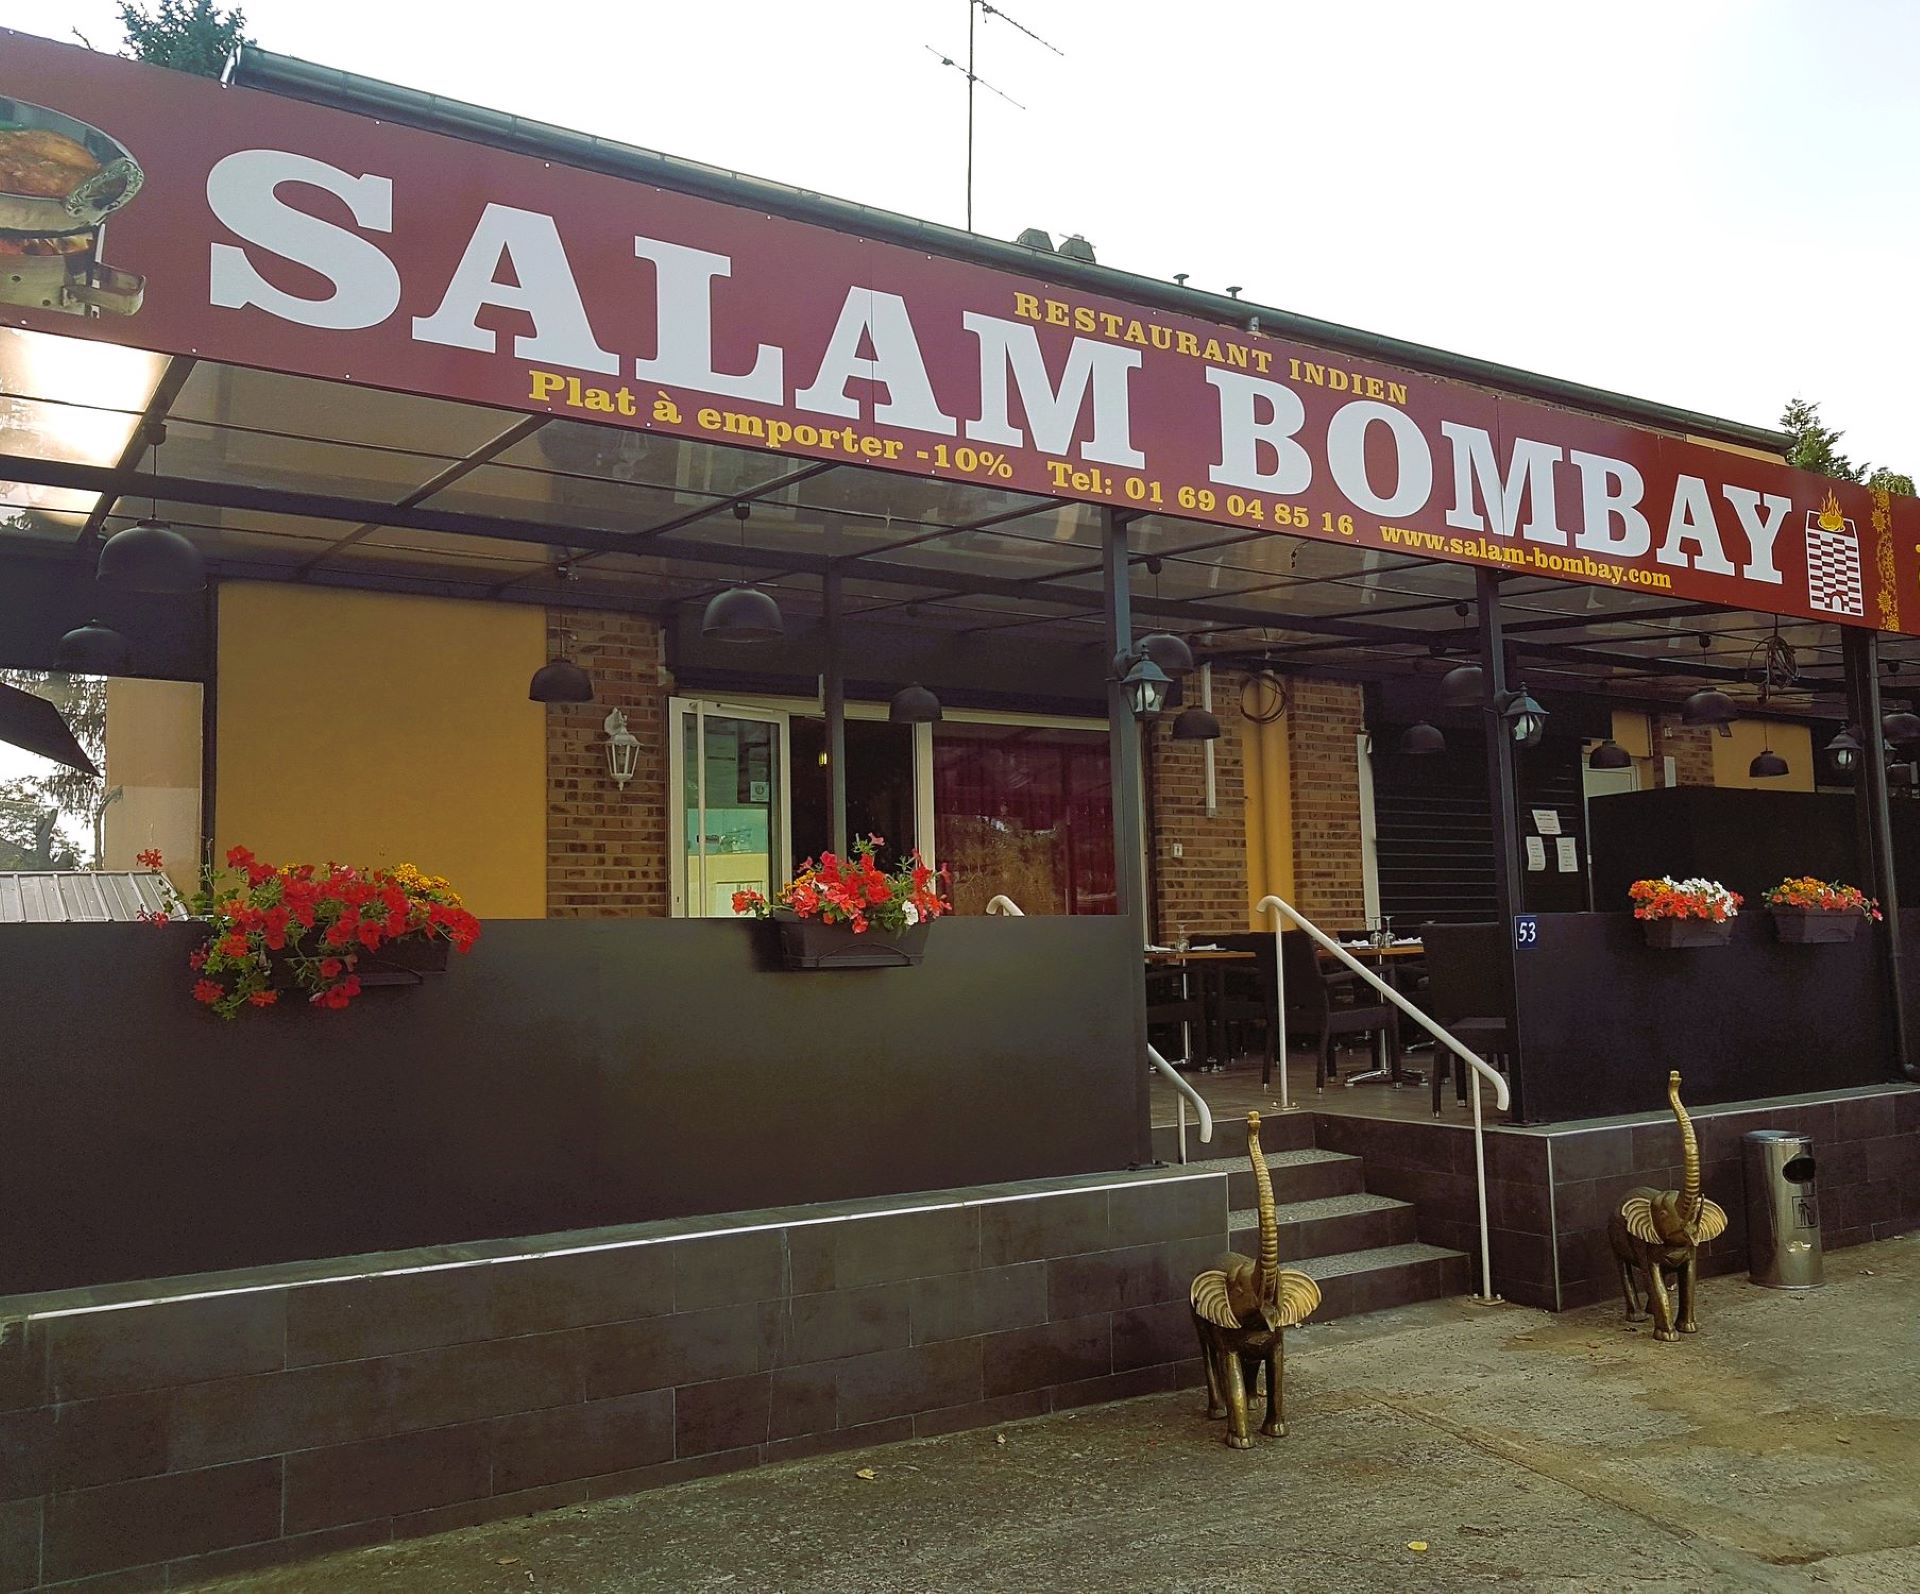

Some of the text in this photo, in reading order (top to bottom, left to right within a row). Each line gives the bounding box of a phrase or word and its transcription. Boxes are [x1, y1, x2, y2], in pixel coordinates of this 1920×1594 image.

[206, 149, 1792, 584] SALAM BOMBAY
[1013, 291, 1408, 406] RESTAURANT INDIEN
[529, 370, 1013, 479] Plat à emporter -10%
[1047, 460, 1355, 537] Tel: 01 69 04 85 16
[1381, 525, 1671, 588] www.salam-bombay.com
[1518, 922, 1536, 943] 53
